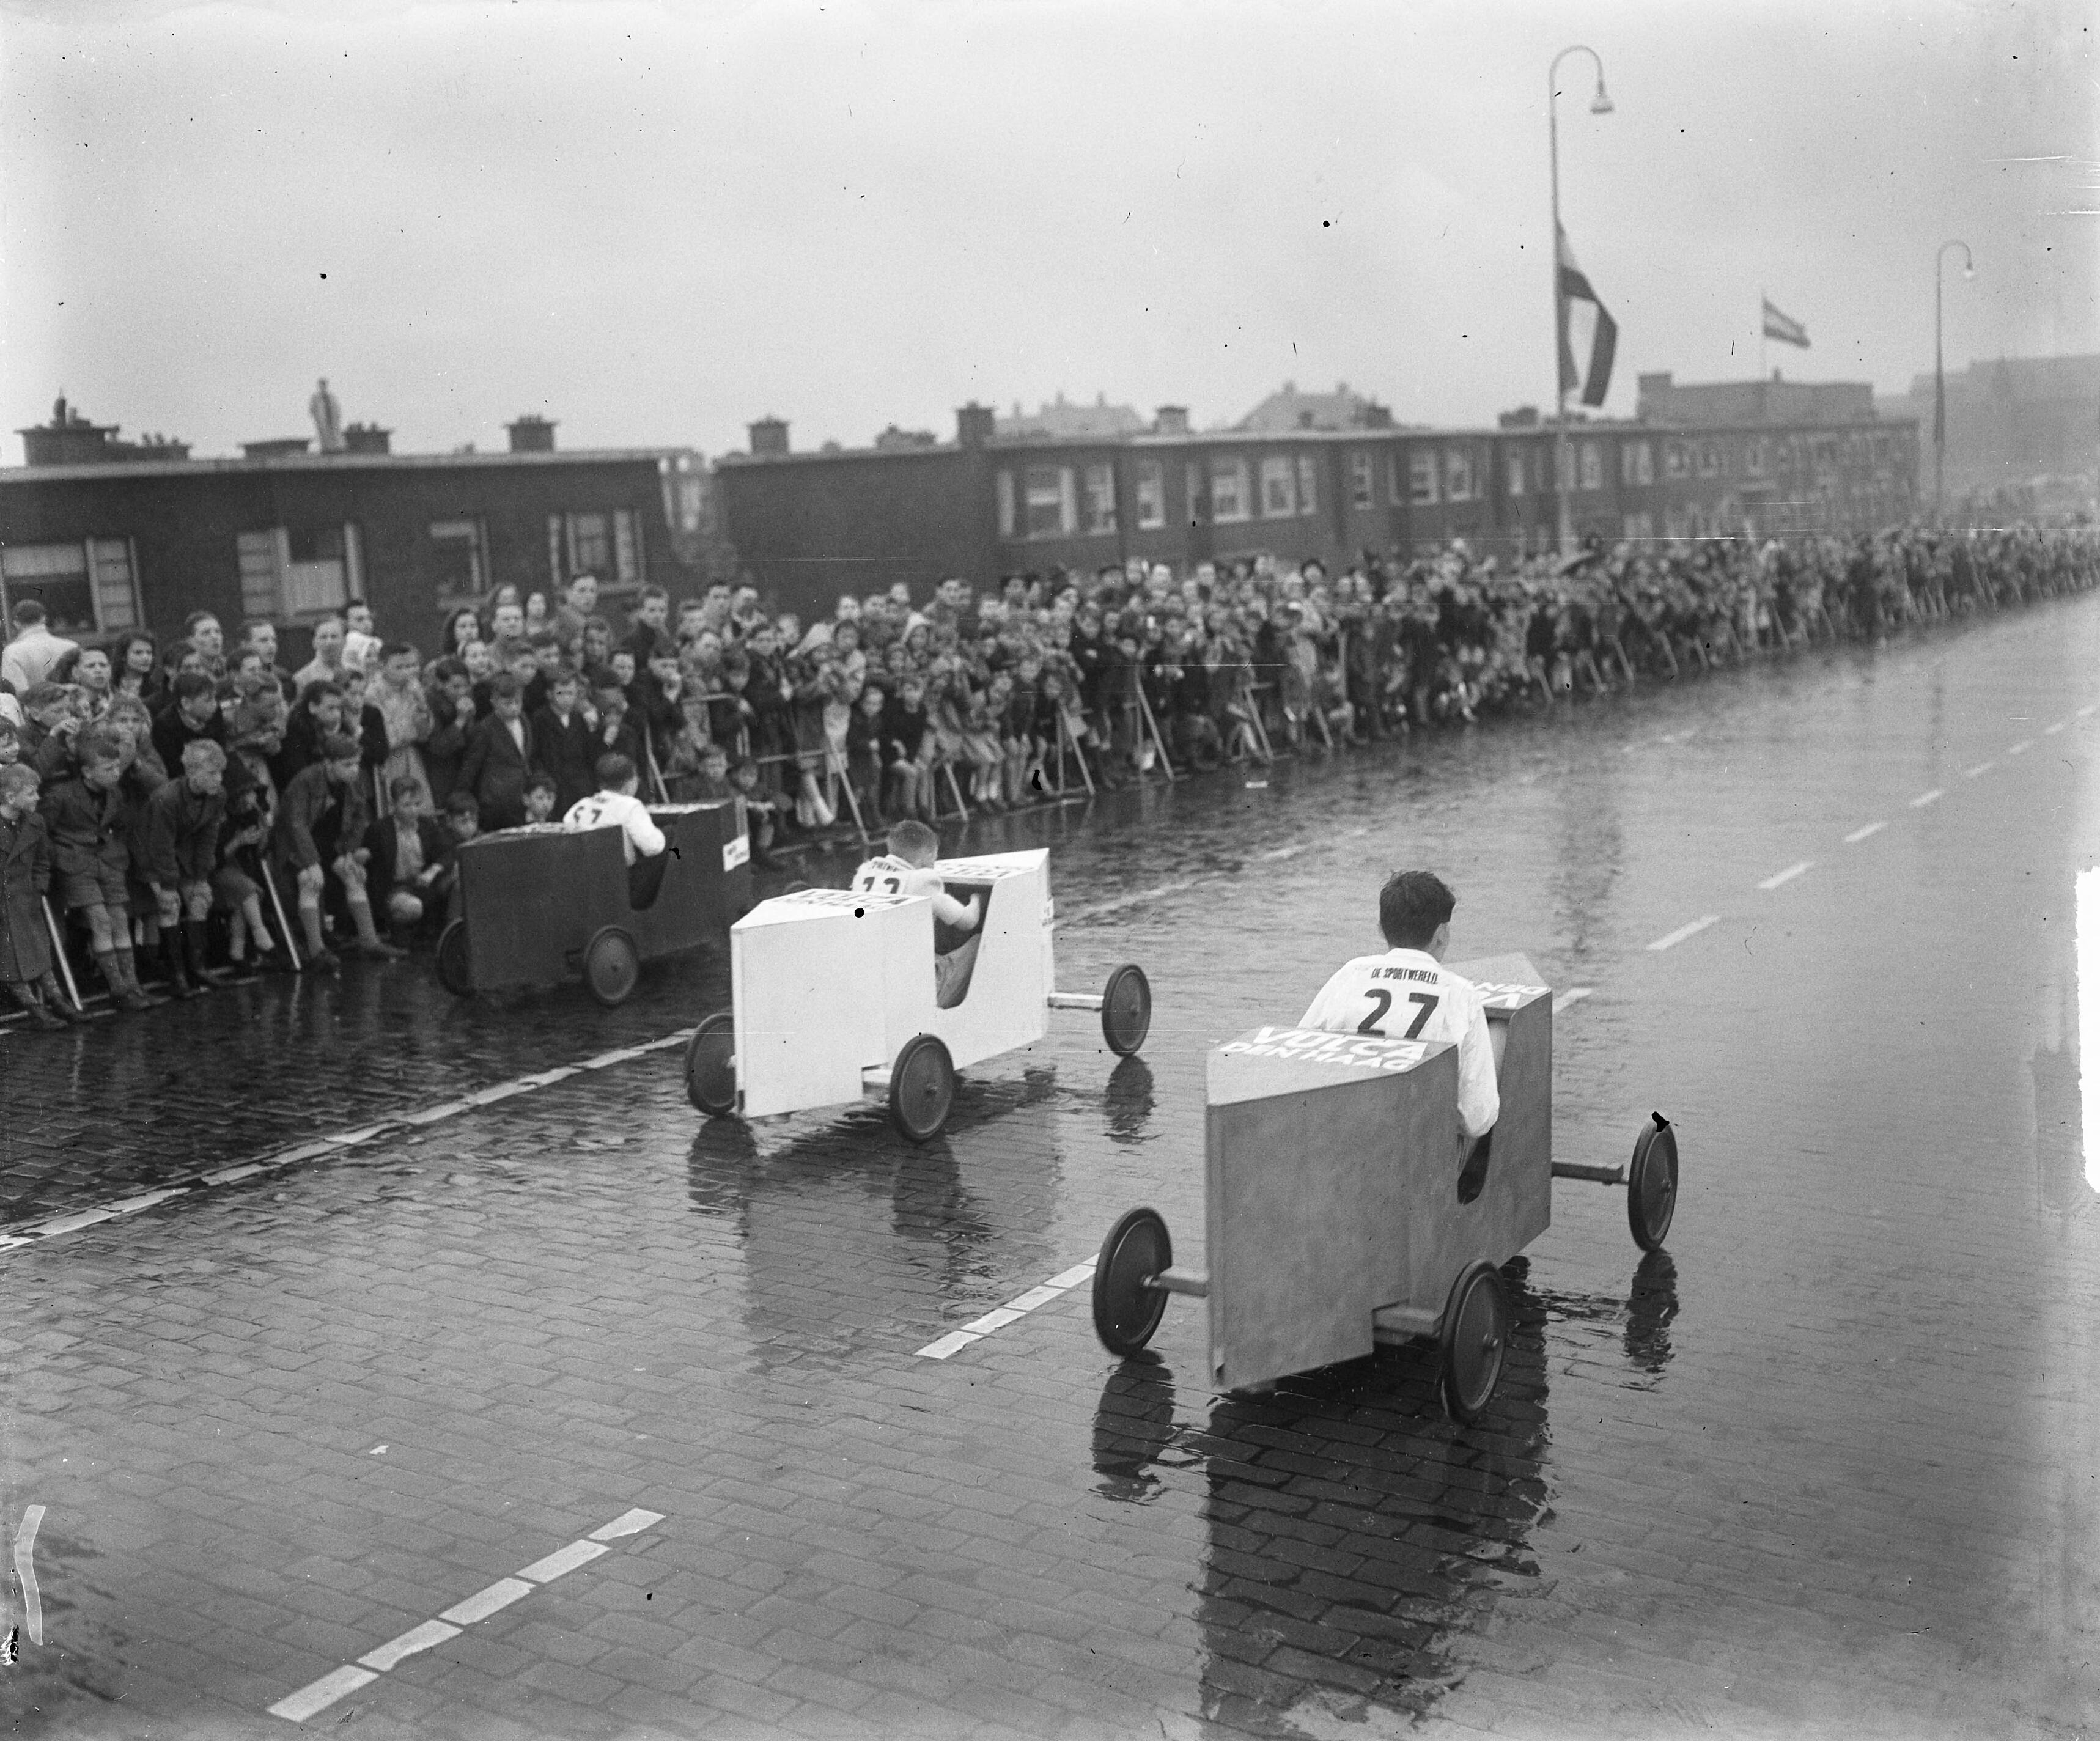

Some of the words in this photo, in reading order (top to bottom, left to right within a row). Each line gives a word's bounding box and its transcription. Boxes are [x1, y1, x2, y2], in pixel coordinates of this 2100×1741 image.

[1371, 968, 1382, 979] DE
[1357, 988, 1439, 1039] 27
[1219, 1042, 1302, 1058] DEN
[1298, 1050, 1415, 1070] HAAG
[1253, 1026, 1428, 1061] VULCA
